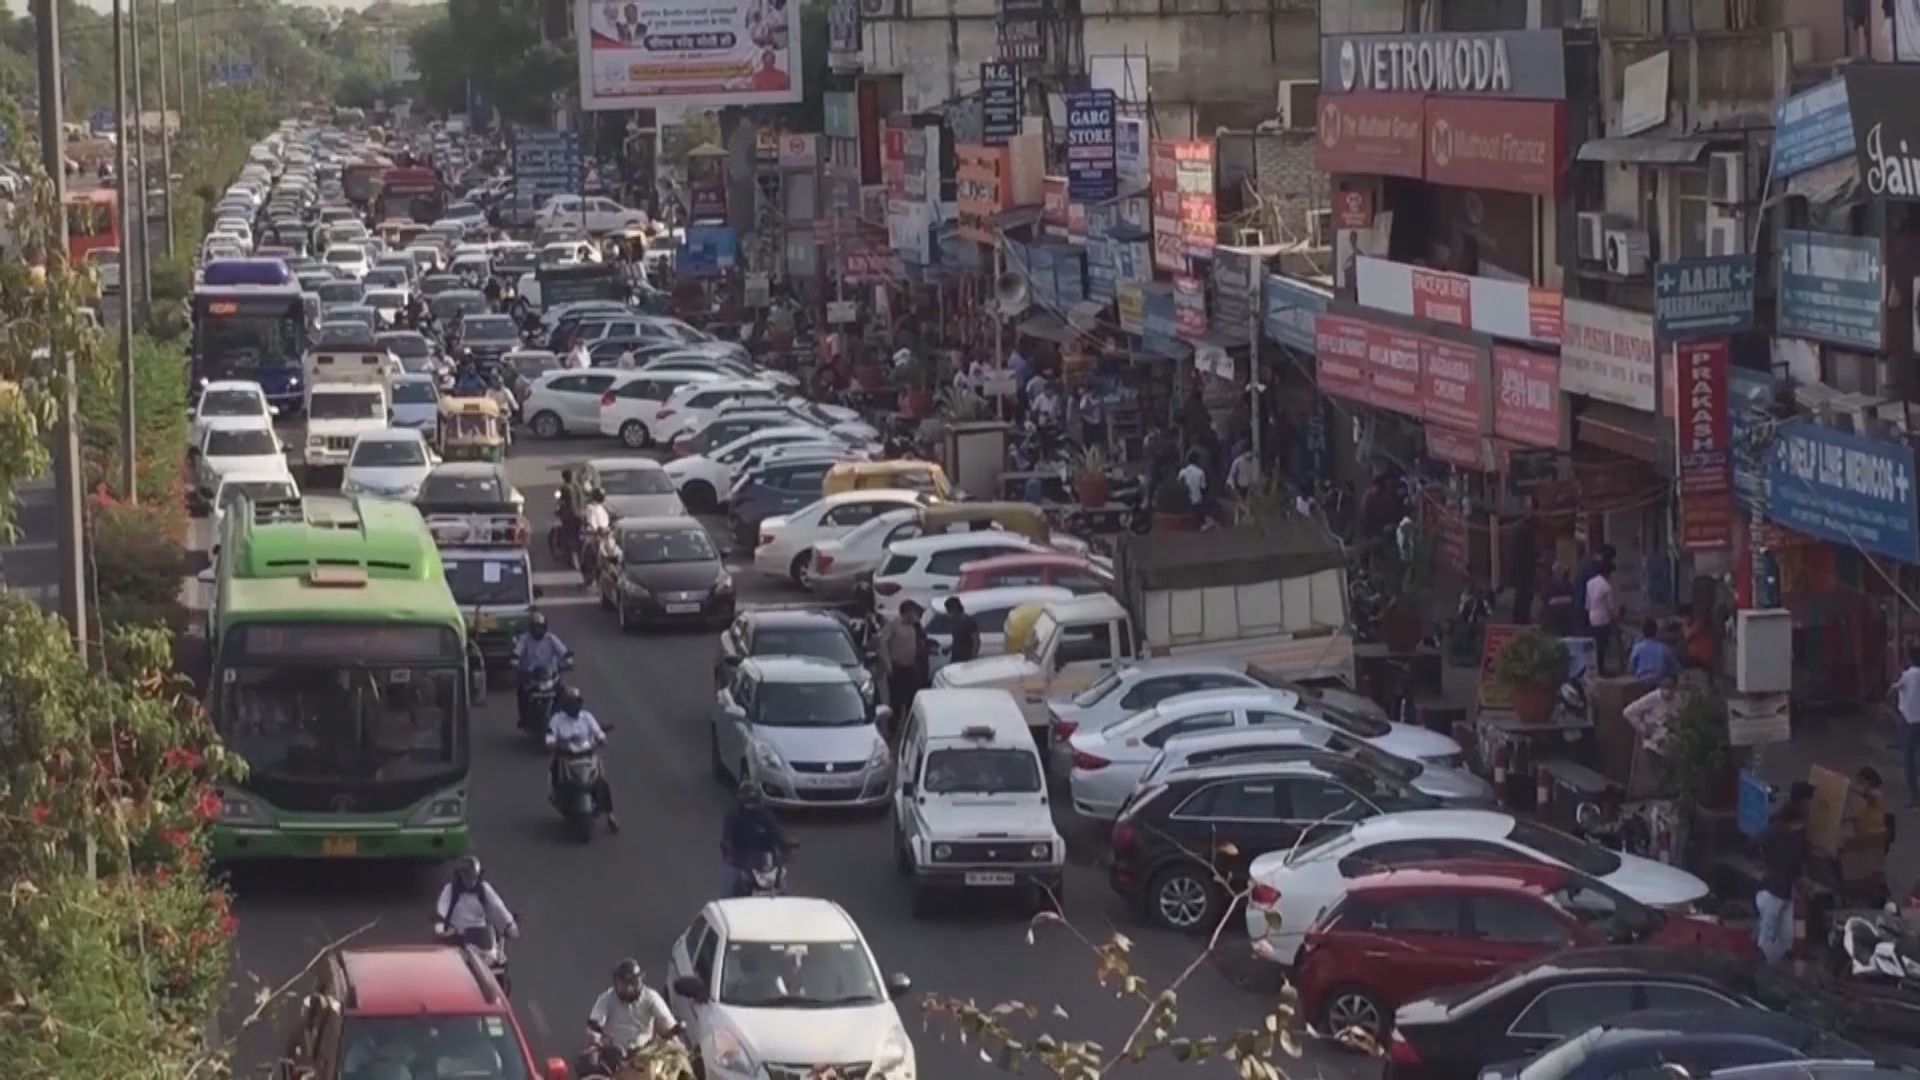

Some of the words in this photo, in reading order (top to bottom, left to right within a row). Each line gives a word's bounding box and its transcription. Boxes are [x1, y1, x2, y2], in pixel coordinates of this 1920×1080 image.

[1359, 37, 1512, 92] VETROMODA
[1070, 109, 1110, 126] GARG
[1068, 128, 1112, 145] STORE
[1501, 132, 1546, 165] Finance
[1678, 264, 1732, 294] AARK
[1691, 351, 1715, 451] PRAKASH
[1789, 436, 1816, 481] HELP
[1818, 441, 1844, 488] LINE
[1845, 448, 1896, 504] MEDICOS
